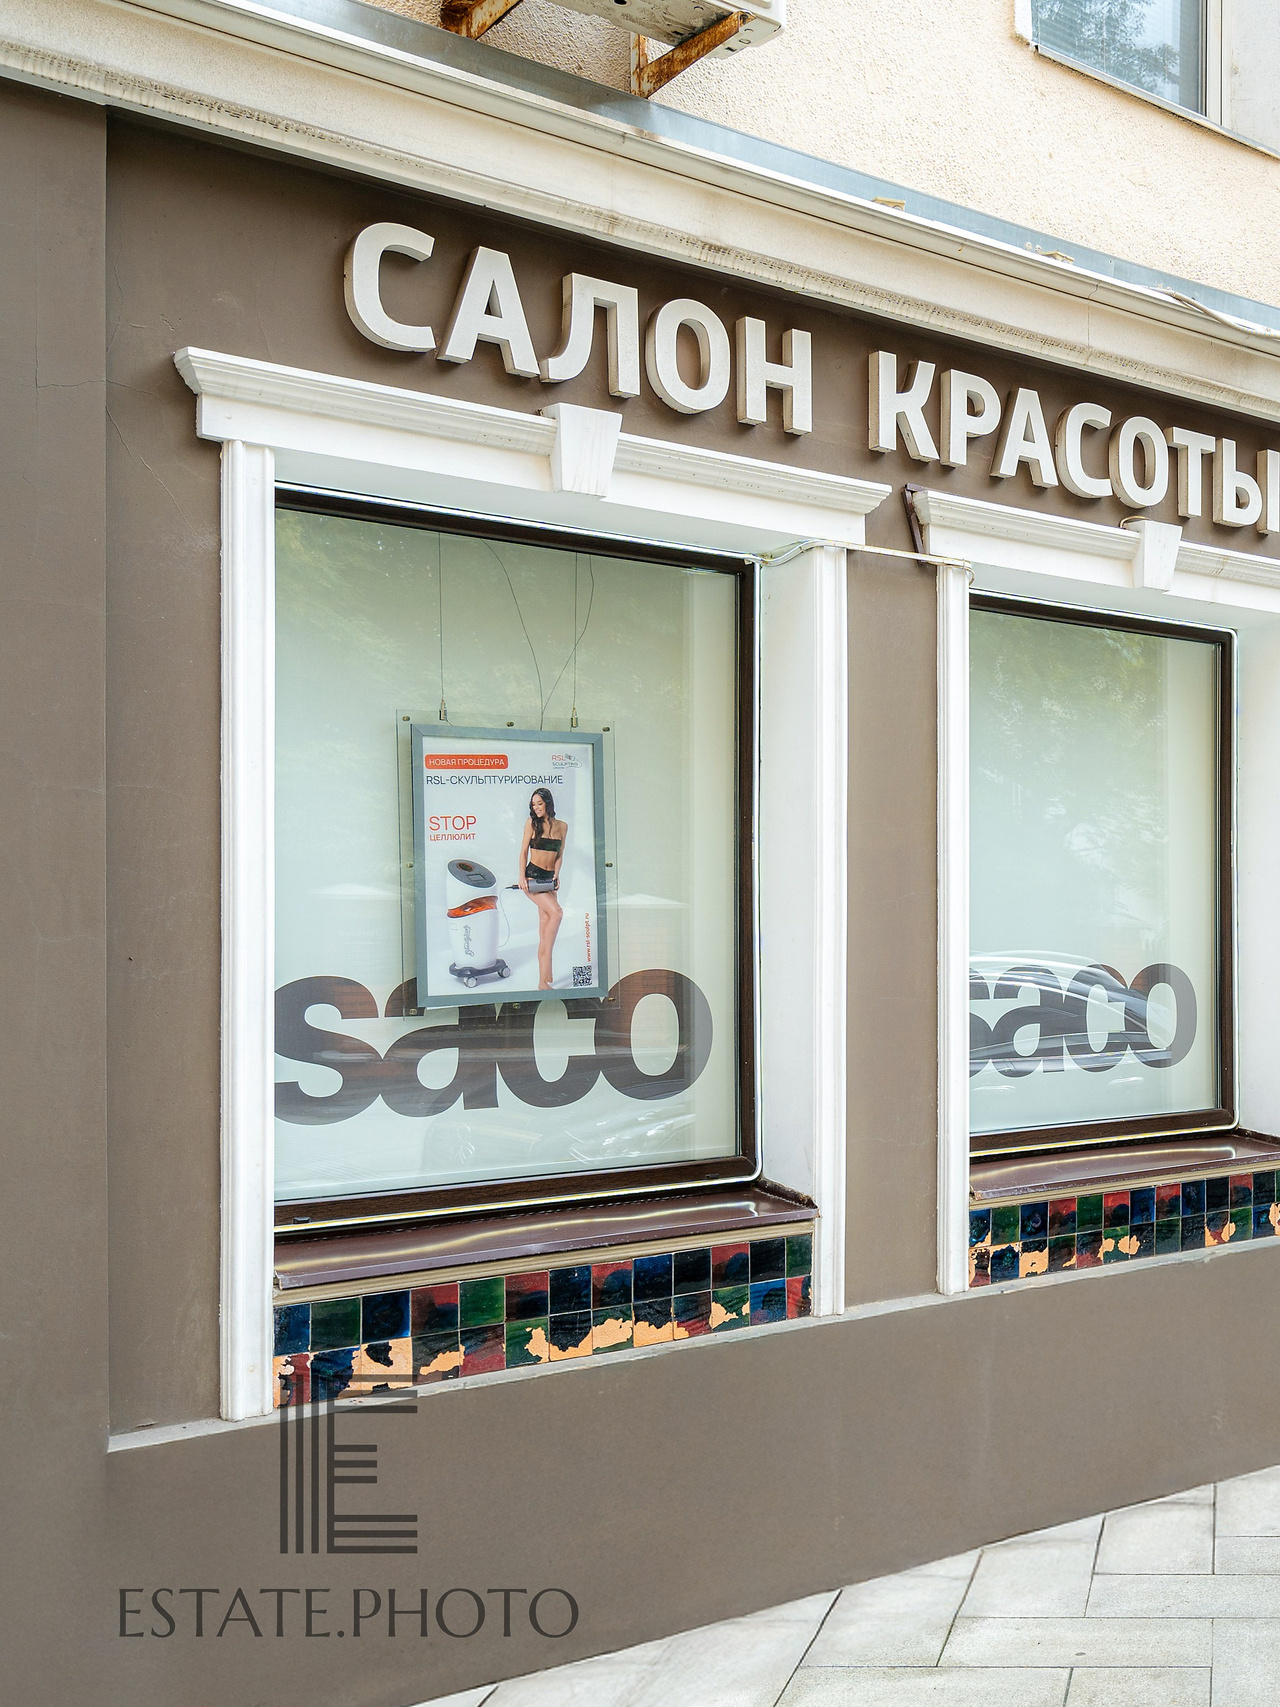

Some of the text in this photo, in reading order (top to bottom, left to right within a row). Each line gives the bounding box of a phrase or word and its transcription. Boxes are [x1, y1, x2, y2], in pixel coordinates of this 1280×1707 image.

[343, 222, 1280, 535] САЛОН КРАСОТЫ
[428, 758, 505, 767] НОВАЯ ПРОЦЕДУРА
[426, 774, 564, 786] RSL-СКУЛЬПТУРИРОВАНИЕ
[429, 815, 477, 831] STOP
[429, 832, 476, 842] ЦЕЛЛЮЛИТ
